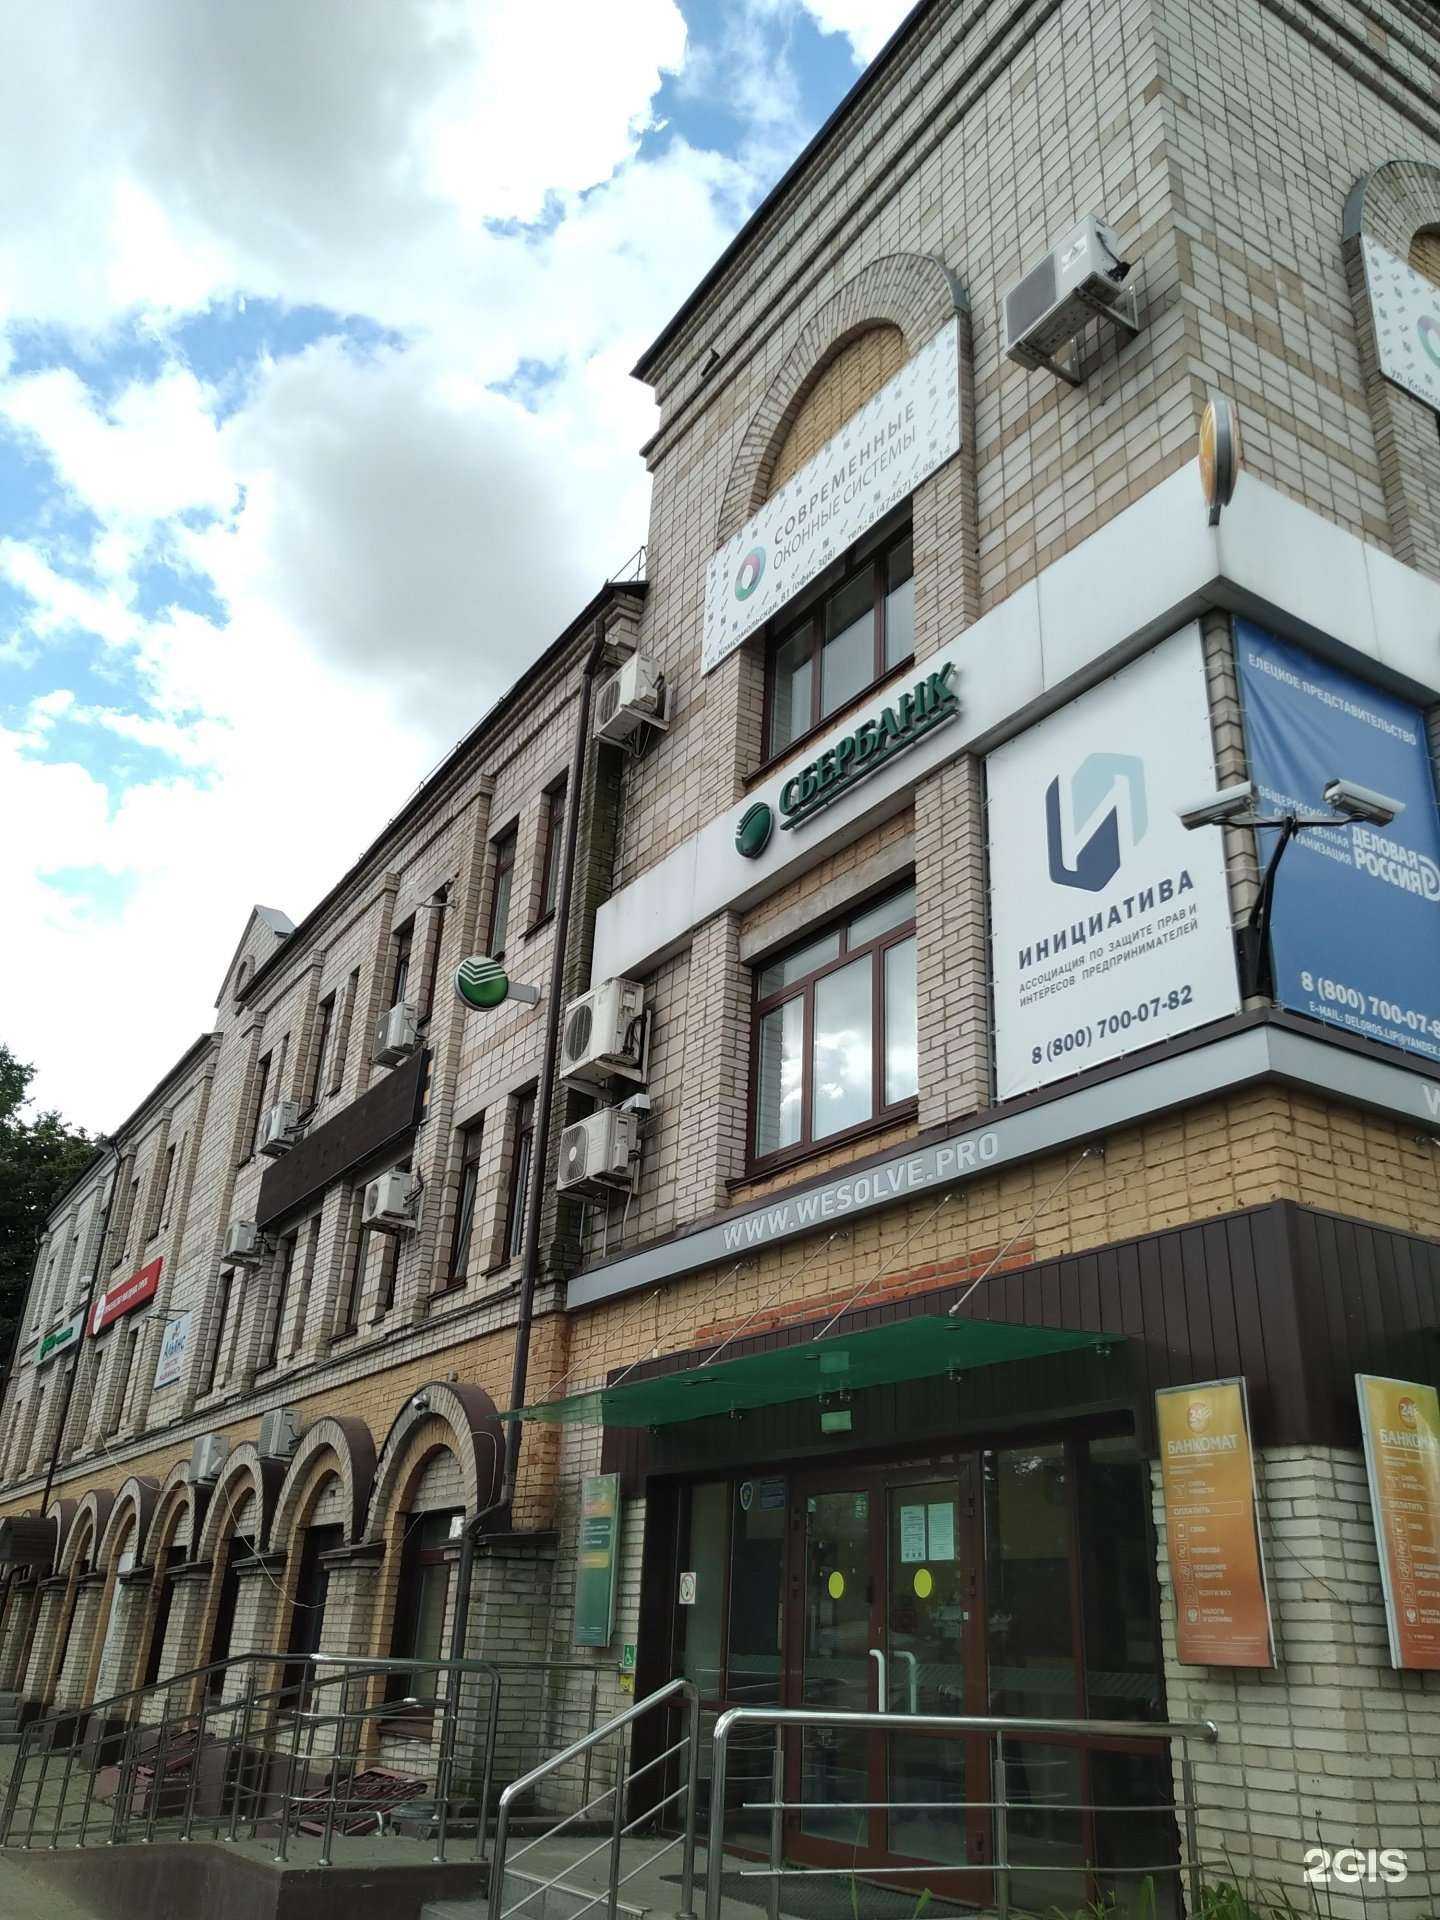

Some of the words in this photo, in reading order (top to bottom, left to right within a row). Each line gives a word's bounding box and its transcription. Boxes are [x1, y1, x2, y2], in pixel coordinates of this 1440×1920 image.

[773, 495, 841, 570] ОКОННЫЕ
[843, 424, 916, 504] СИСТЕМЫ
[774, 400, 915, 545] СОВРЕМЕННЫЕ
[779, 661, 960, 817] СБЕРБАНК
[1248, 653, 1300, 689] ЕЛЕЦКОЕ
[1302, 681, 1417, 746] ПРЕДСТАВИТЕЛЬСТВО
[1352, 825, 1419, 870] ДЕЛОВАЯ
[1353, 846, 1424, 896] РОССИЯ
[1018, 869, 1194, 970] ИНИЦИАТИВА
[1019, 955, 1085, 994] АССОЦИАЦИЯ
[1089, 947, 1104, 961] ПО
[1108, 924, 1153, 952] ЗАЩИТЕ
[1157, 908, 1186, 929] ПРАВ
[1188, 903, 1197, 914] И
[1019, 975, 1076, 1008] ИНТЕРЕСОВ
[1081, 918, 1199, 981] ПРЕДПРИНИМАТЕЛЕЙ
[1031, 1046, 1042, 1065] 8
[1046, 1026, 1092, 1063] (800)
[1097, 984, 1193, 1039] 700-07-82
[1300, 971, 1314, 992] 8
[1318, 977, 1366, 1015] (800)
[723, 1132, 999, 1250] WWW.WESOLVE.PRO
[1167, 1433, 1239, 1455] БАНКОМАТ
